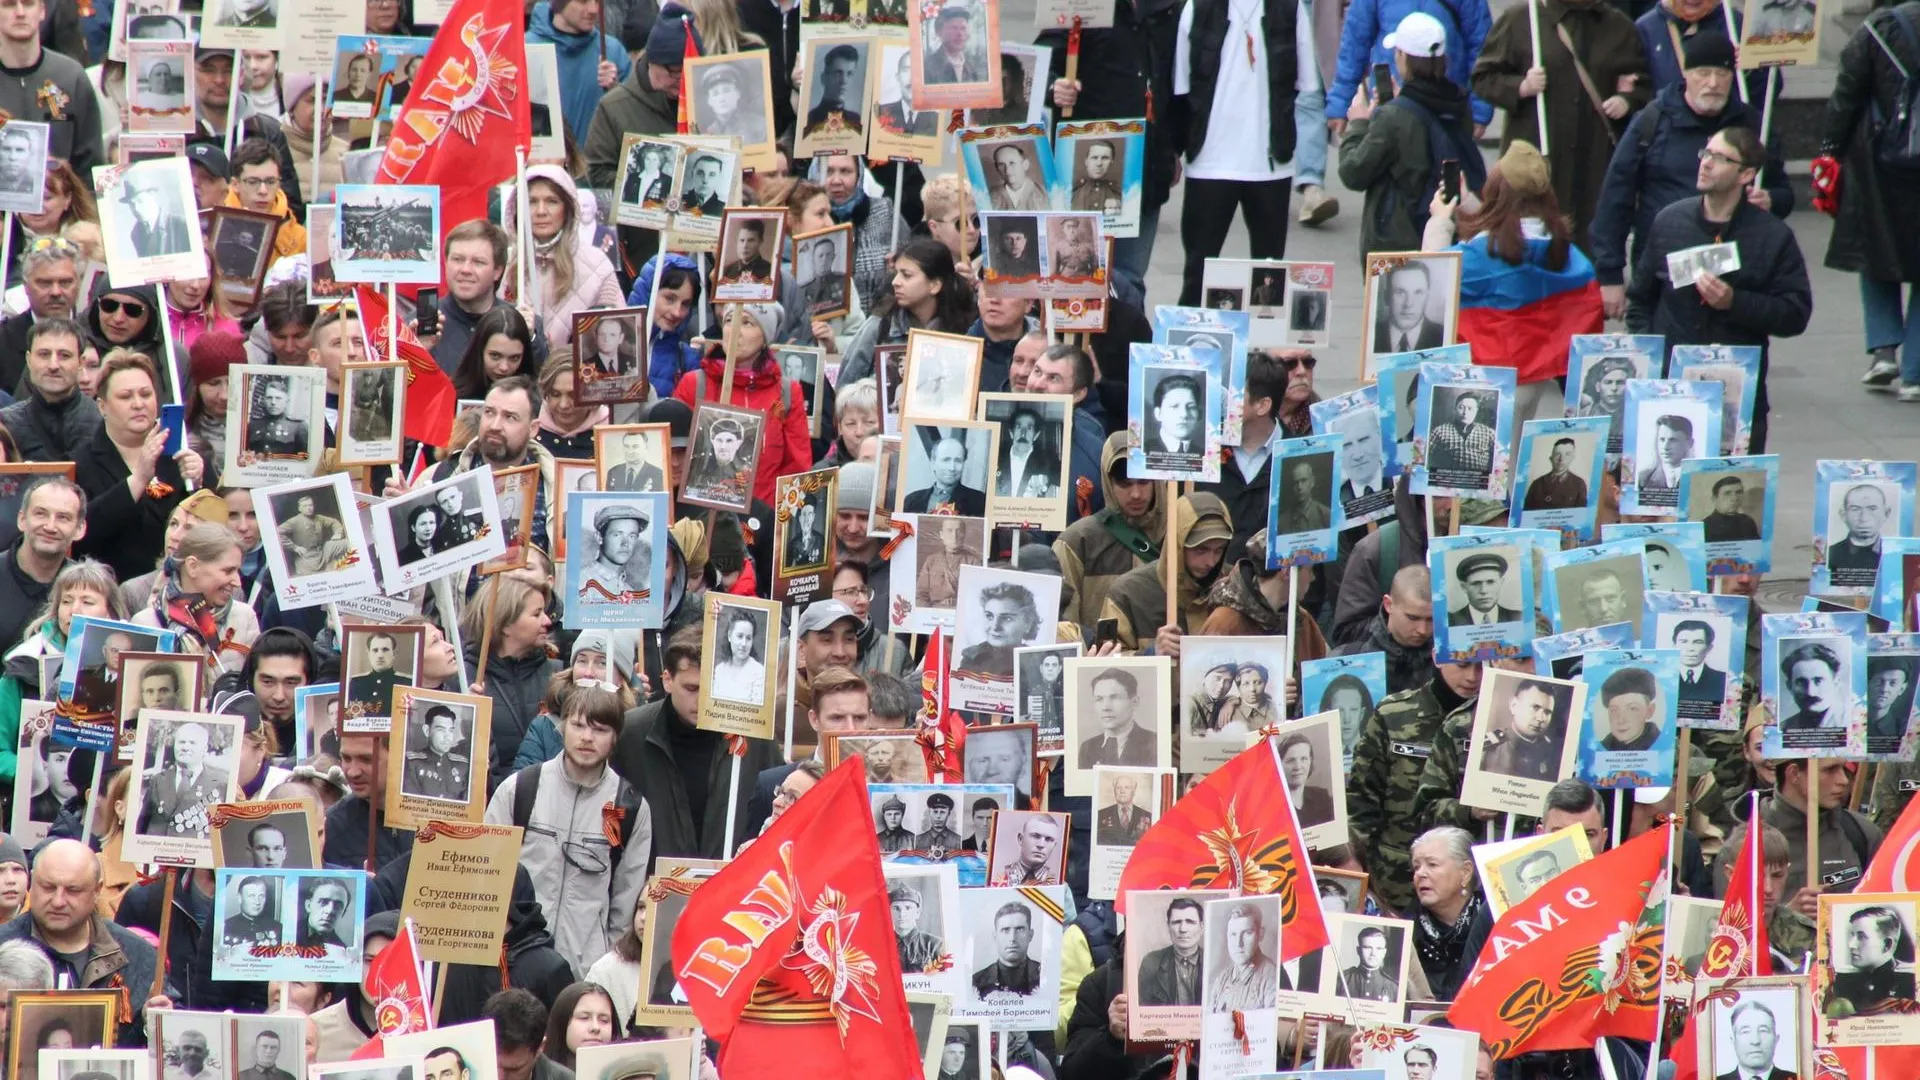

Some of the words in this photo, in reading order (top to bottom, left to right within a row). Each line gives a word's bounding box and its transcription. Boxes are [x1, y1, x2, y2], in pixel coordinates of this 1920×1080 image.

[789, 574, 819, 587] КОЧКАРОВ
[712, 700, 760, 715] Александрова
[726, 713, 767, 726] Васильевна
[281, 802, 304, 812] ПОЛК
[490, 828, 513, 838] ПОЛК
[440, 849, 491, 866] Ефимов
[426, 861, 451, 873] Иван
[452, 864, 501, 877] Ефимович
[418, 885, 499, 903] Студенников
[412, 897, 447, 910] Сергей
[448, 899, 500, 914] Фёдорович
[411, 921, 496, 941] Студенникова
[437, 937, 490, 951] Георгиевна
[987, 998, 1024, 1007] Ковалев
[961, 1008, 1001, 1018] Тимофей
[1002, 1007, 1051, 1017] Борисович
